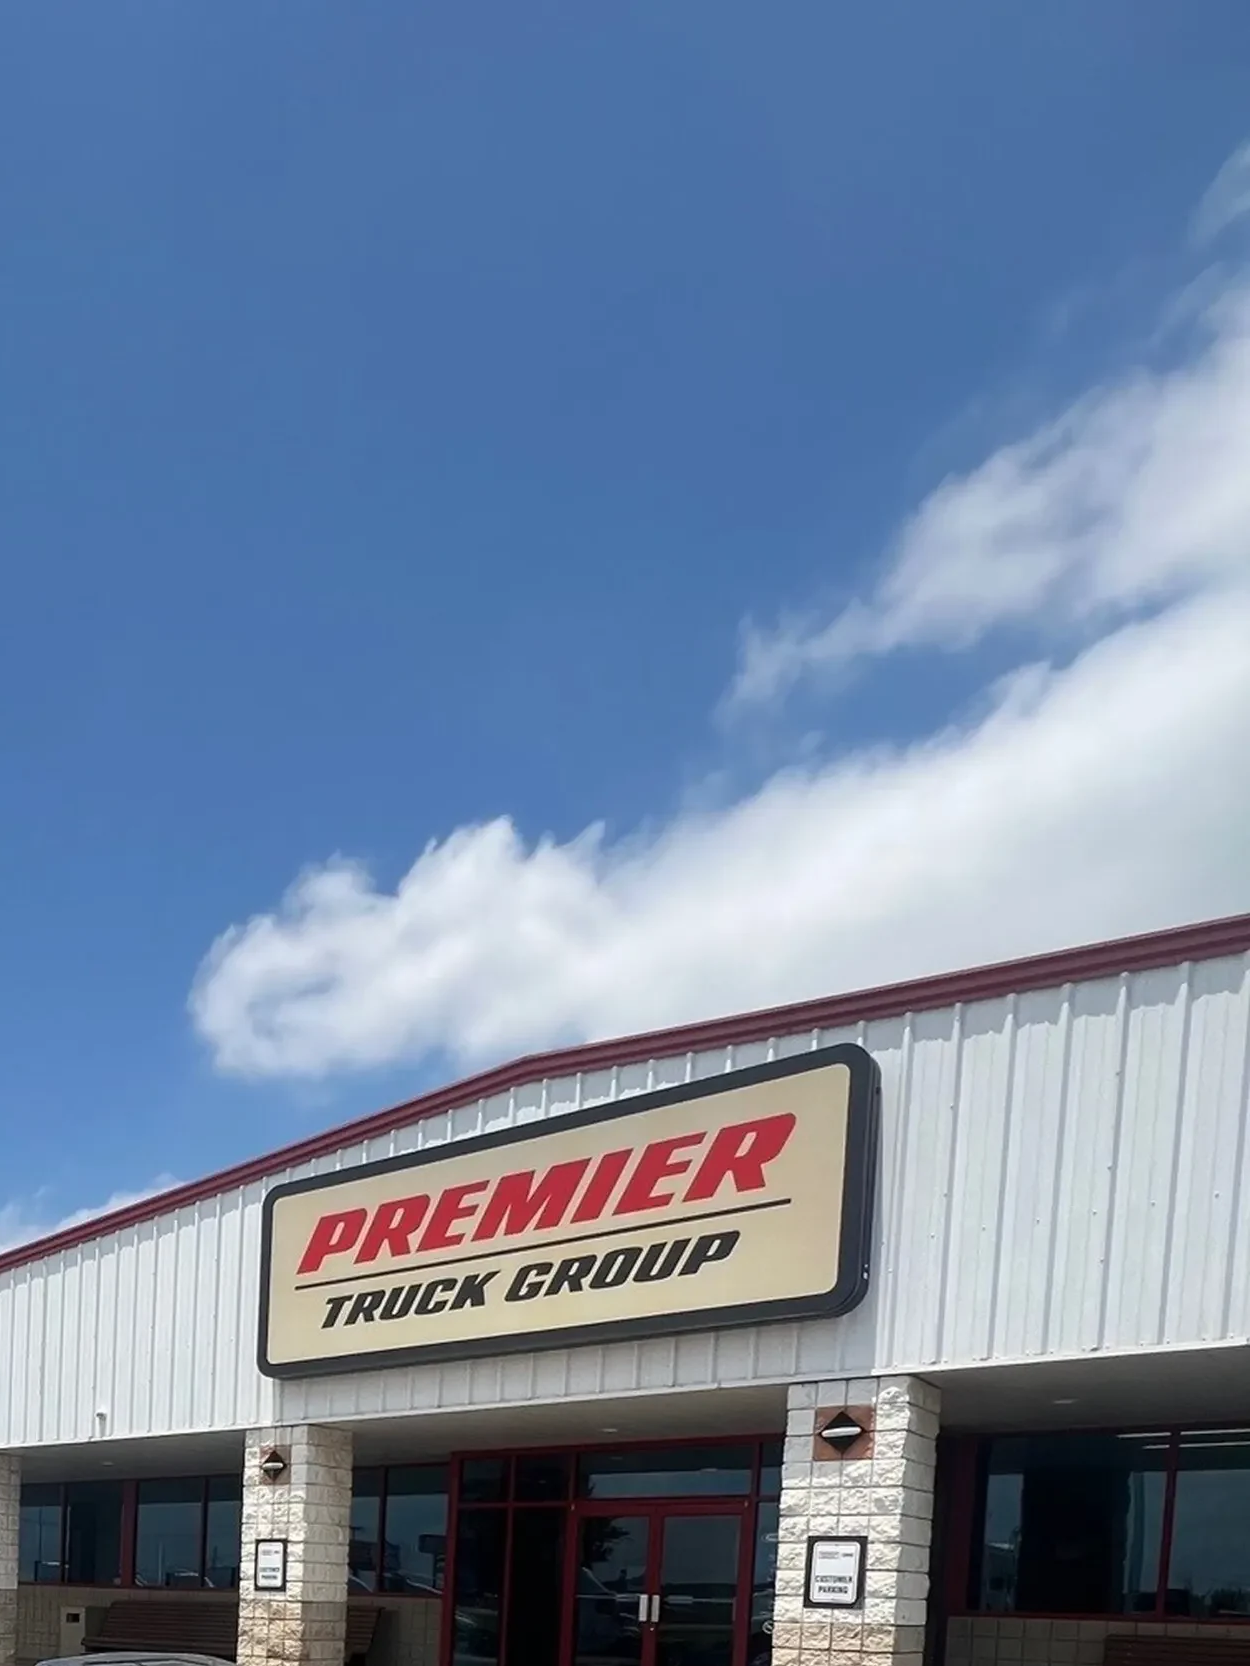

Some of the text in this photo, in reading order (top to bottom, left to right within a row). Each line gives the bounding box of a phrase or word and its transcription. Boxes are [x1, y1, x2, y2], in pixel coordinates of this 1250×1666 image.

[296, 1112, 797, 1275] PREMIER
[320, 1229, 741, 1329] TRUCK GROUP
